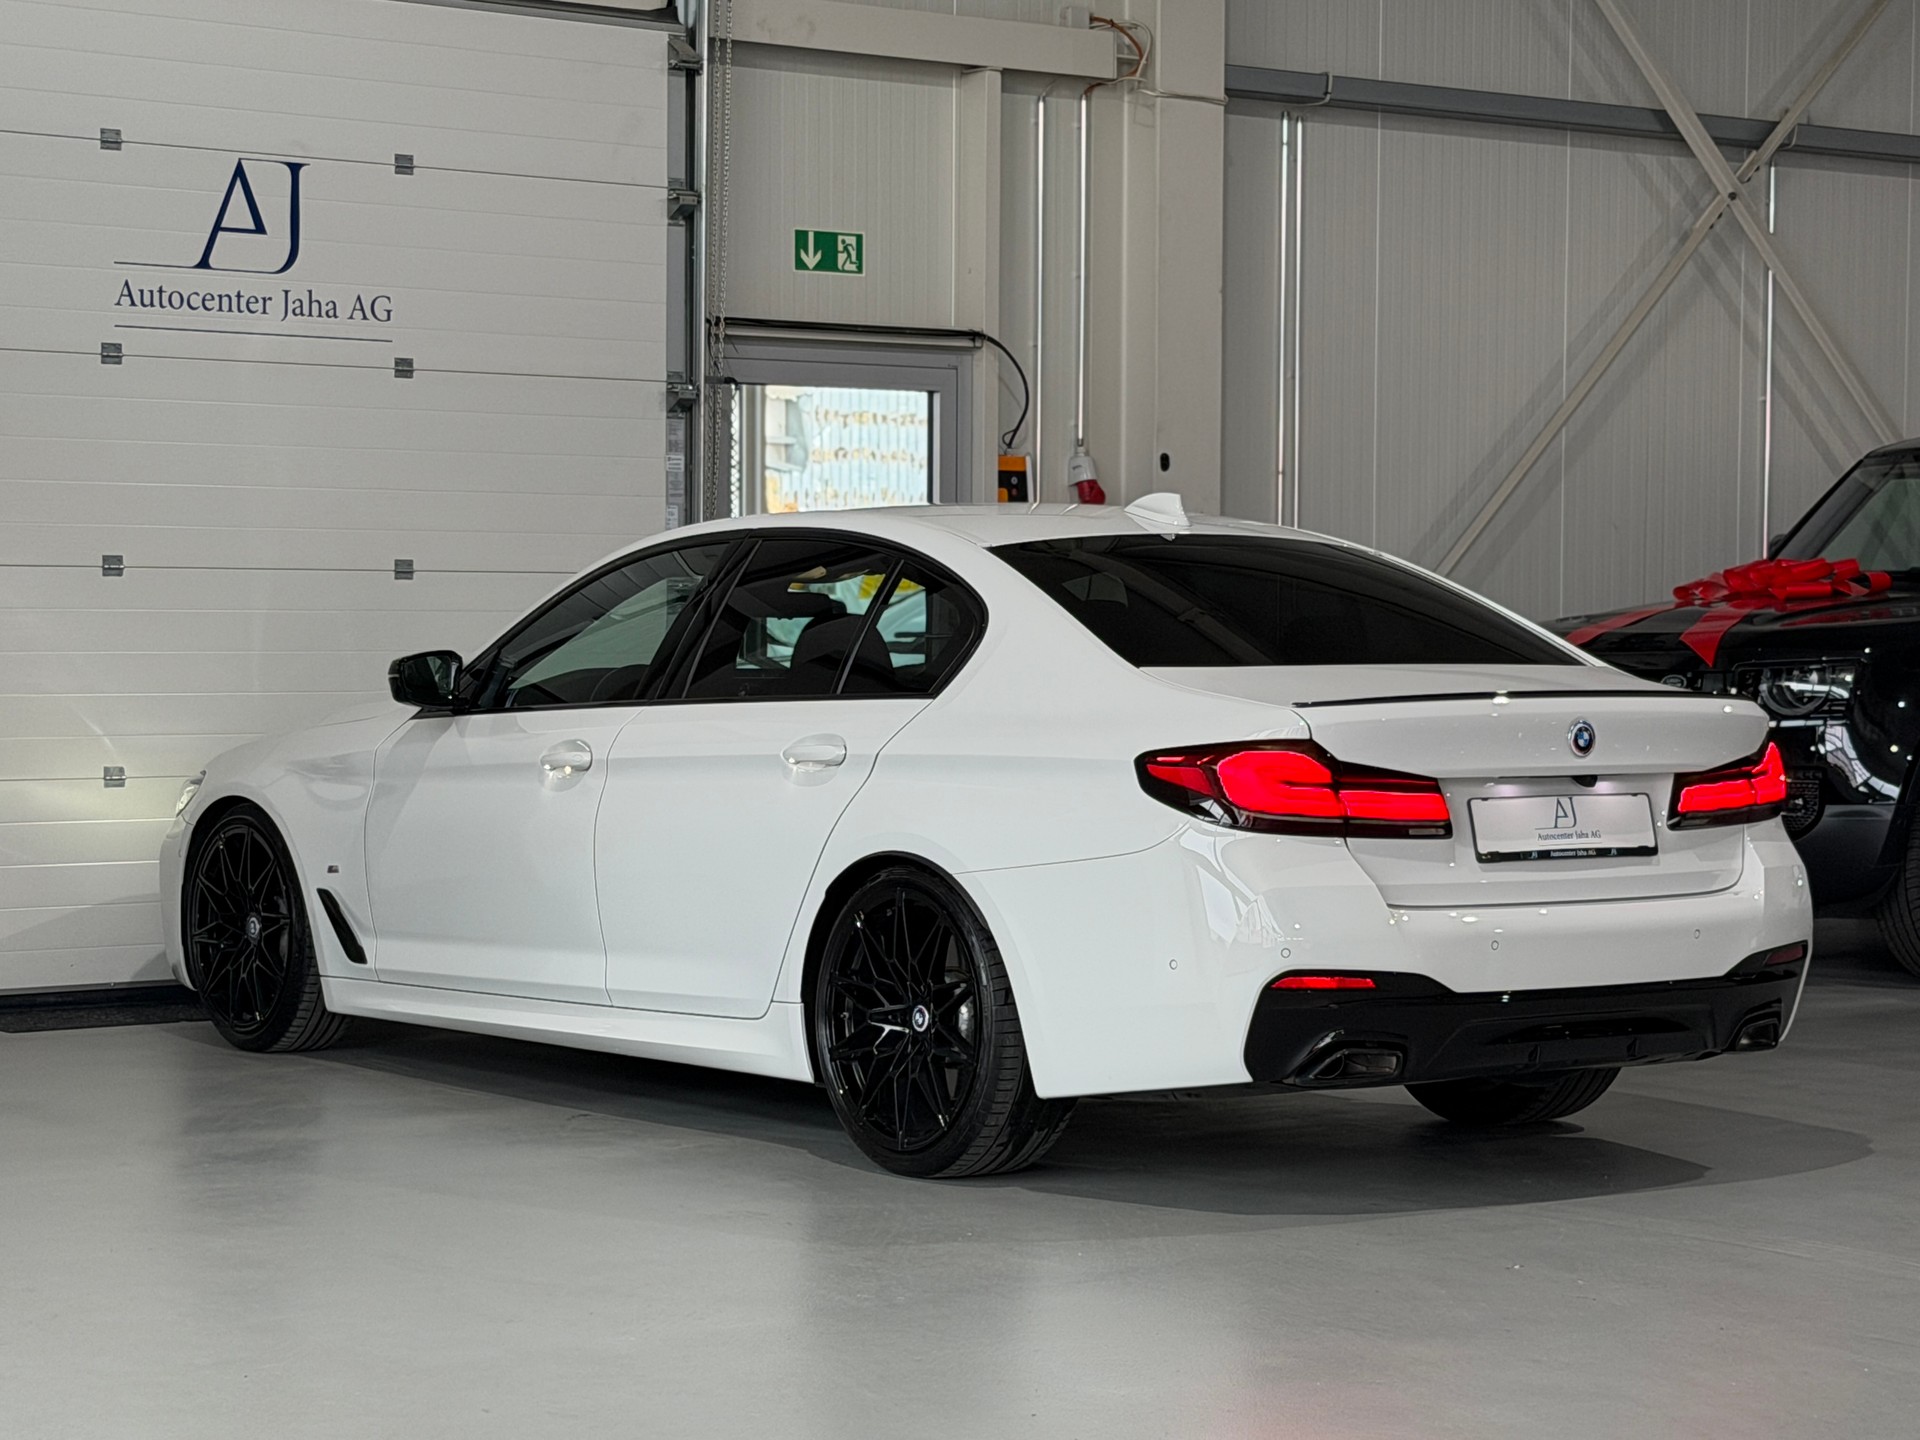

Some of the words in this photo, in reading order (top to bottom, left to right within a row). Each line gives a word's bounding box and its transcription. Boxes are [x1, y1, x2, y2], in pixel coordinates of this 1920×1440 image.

[192, 157, 311, 275] AJ
[114, 278, 273, 315] Autocenter
[280, 288, 339, 322] Jaha
[347, 293, 393, 322] AG
[1553, 796, 1577, 829] AJ
[1537, 832, 1574, 841] Autocenter
[1591, 829, 1602, 839] AG
